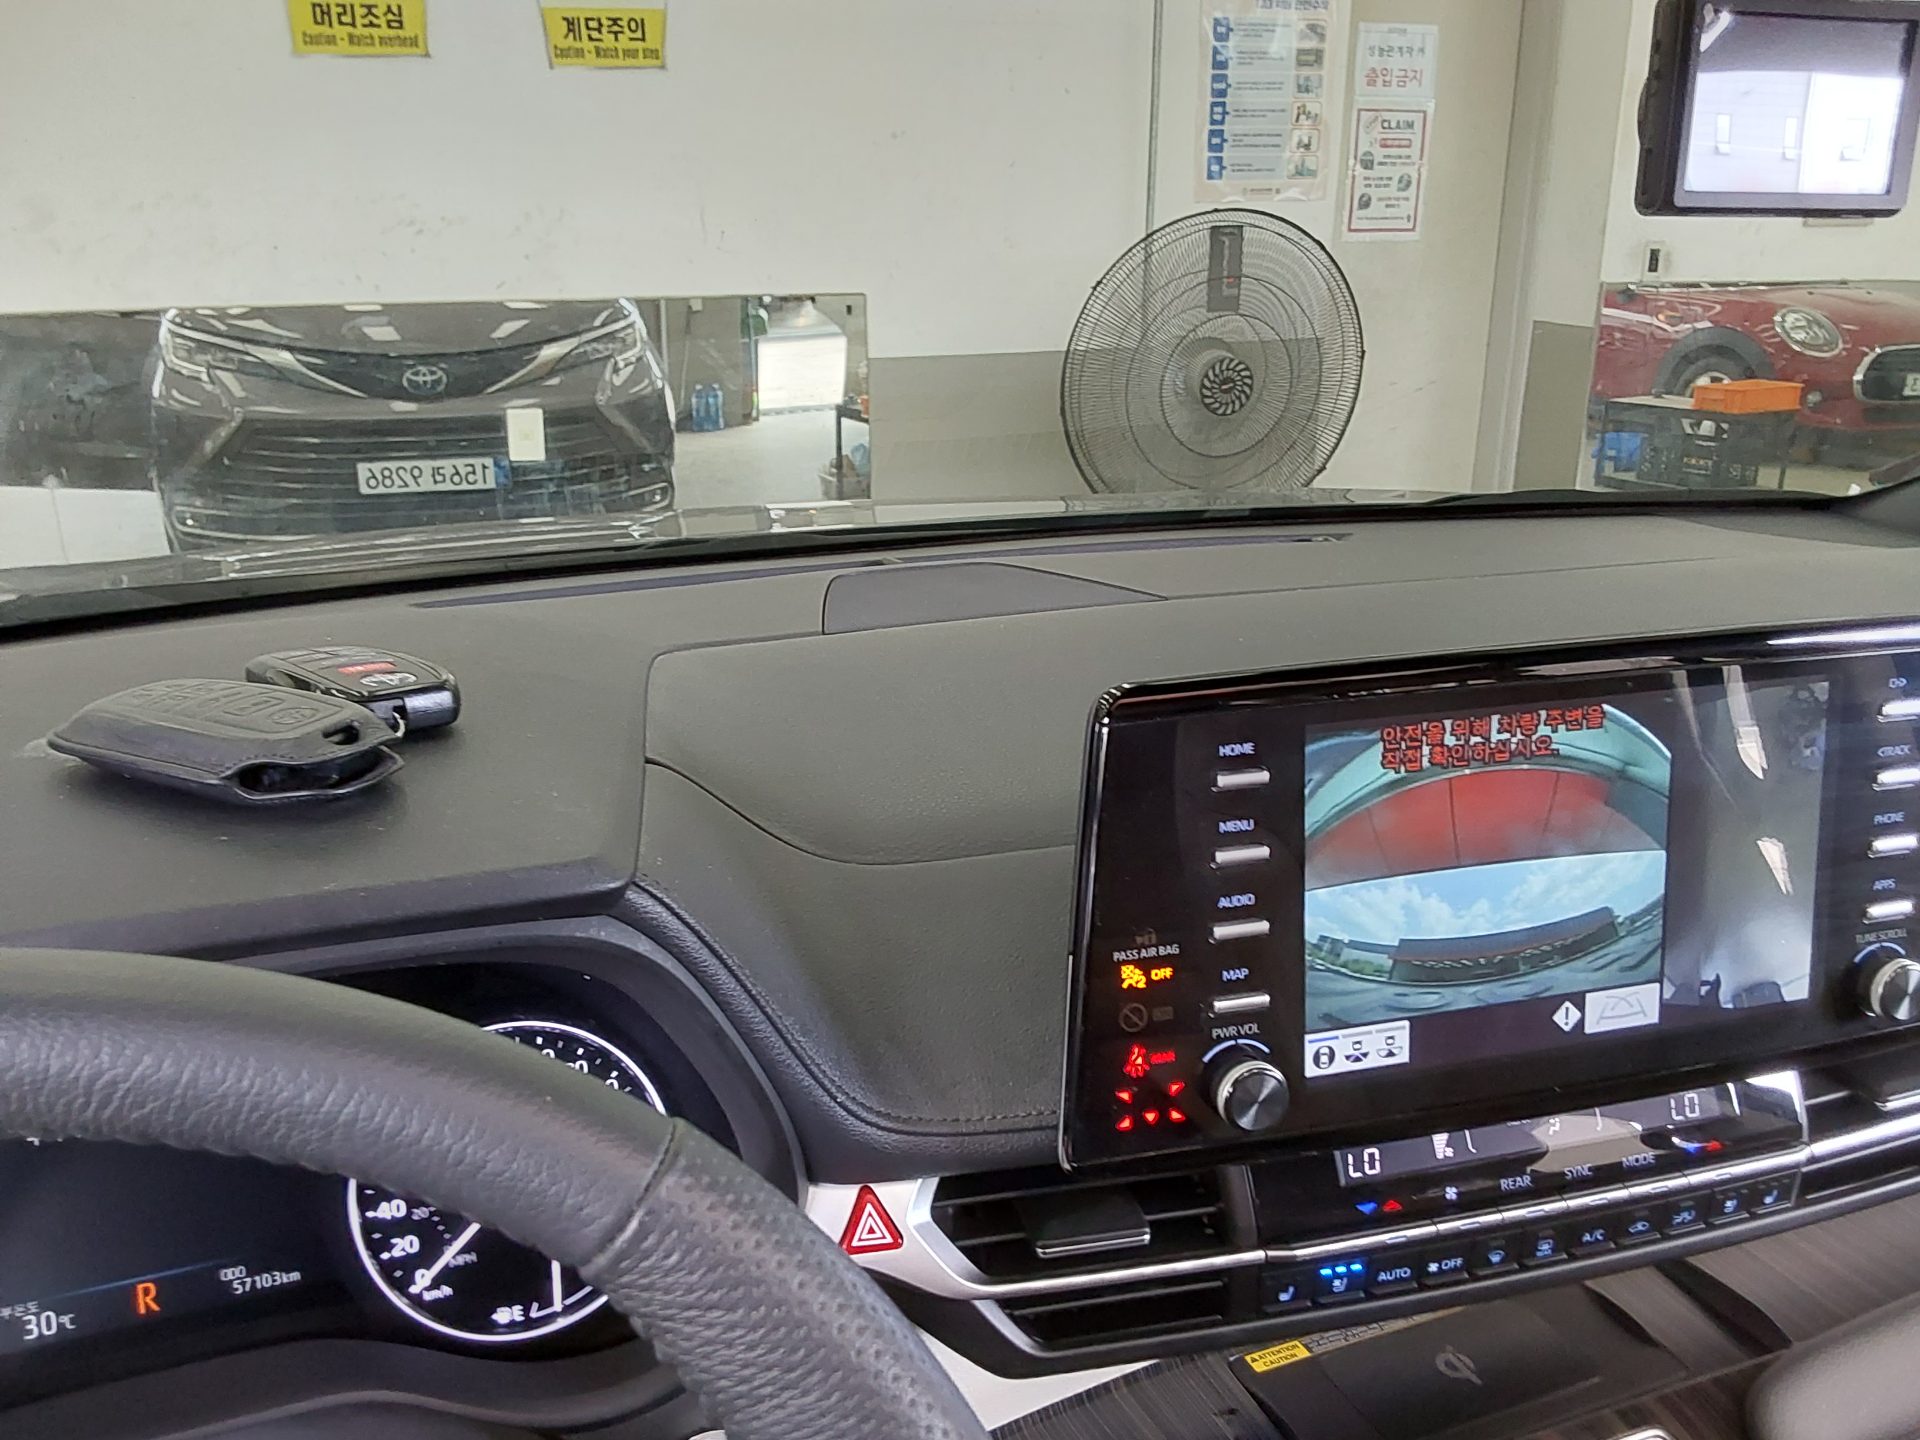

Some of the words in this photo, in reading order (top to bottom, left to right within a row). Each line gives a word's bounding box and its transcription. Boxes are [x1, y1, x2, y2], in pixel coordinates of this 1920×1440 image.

[311, 3, 404, 30] 머리조심
[562, 15, 646, 42] 계단주의
[1365, 67, 1424, 88] 출입금지
[1381, 119, 1415, 130] CLAIM
[1381, 720, 1445, 749] 안전을
[1452, 716, 1491, 742] 위해
[1500, 712, 1539, 737] 차량
[1546, 704, 1605, 731] 주변을
[1218, 742, 1255, 756] HOME
[1382, 748, 1421, 773] 직접
[1218, 818, 1254, 833] MENU
[1873, 812, 1905, 824] PHONE
[1873, 878, 1896, 891] APPS
[1217, 893, 1255, 909] AUDIO
[1113, 950, 1139, 962] PASS
[1140, 947, 1158, 959] AIR
[1158, 944, 1180, 956] BAG
[1150, 967, 1174, 981] OFF
[1222, 968, 1249, 981] MAP
[1211, 1025, 1239, 1040] PWR
[1239, 1023, 1260, 1036] VOL
[1622, 1152, 1656, 1168] MODE
[1564, 1163, 1593, 1180] SYNC
[1500, 1174, 1533, 1192] REAR
[376, 1199, 407, 1220] 40
[1582, 1229, 1605, 1243] A/C
[390, 1235, 420, 1257] 20
[1441, 1257, 1464, 1270] OFF
[219, 1265, 247, 1281] ODO
[1377, 1266, 1411, 1282] AUTO
[135, 1282, 160, 1315] R
[1258, 1343, 1300, 1361] ATTENTION
[1263, 1353, 1298, 1367] CAUTION
